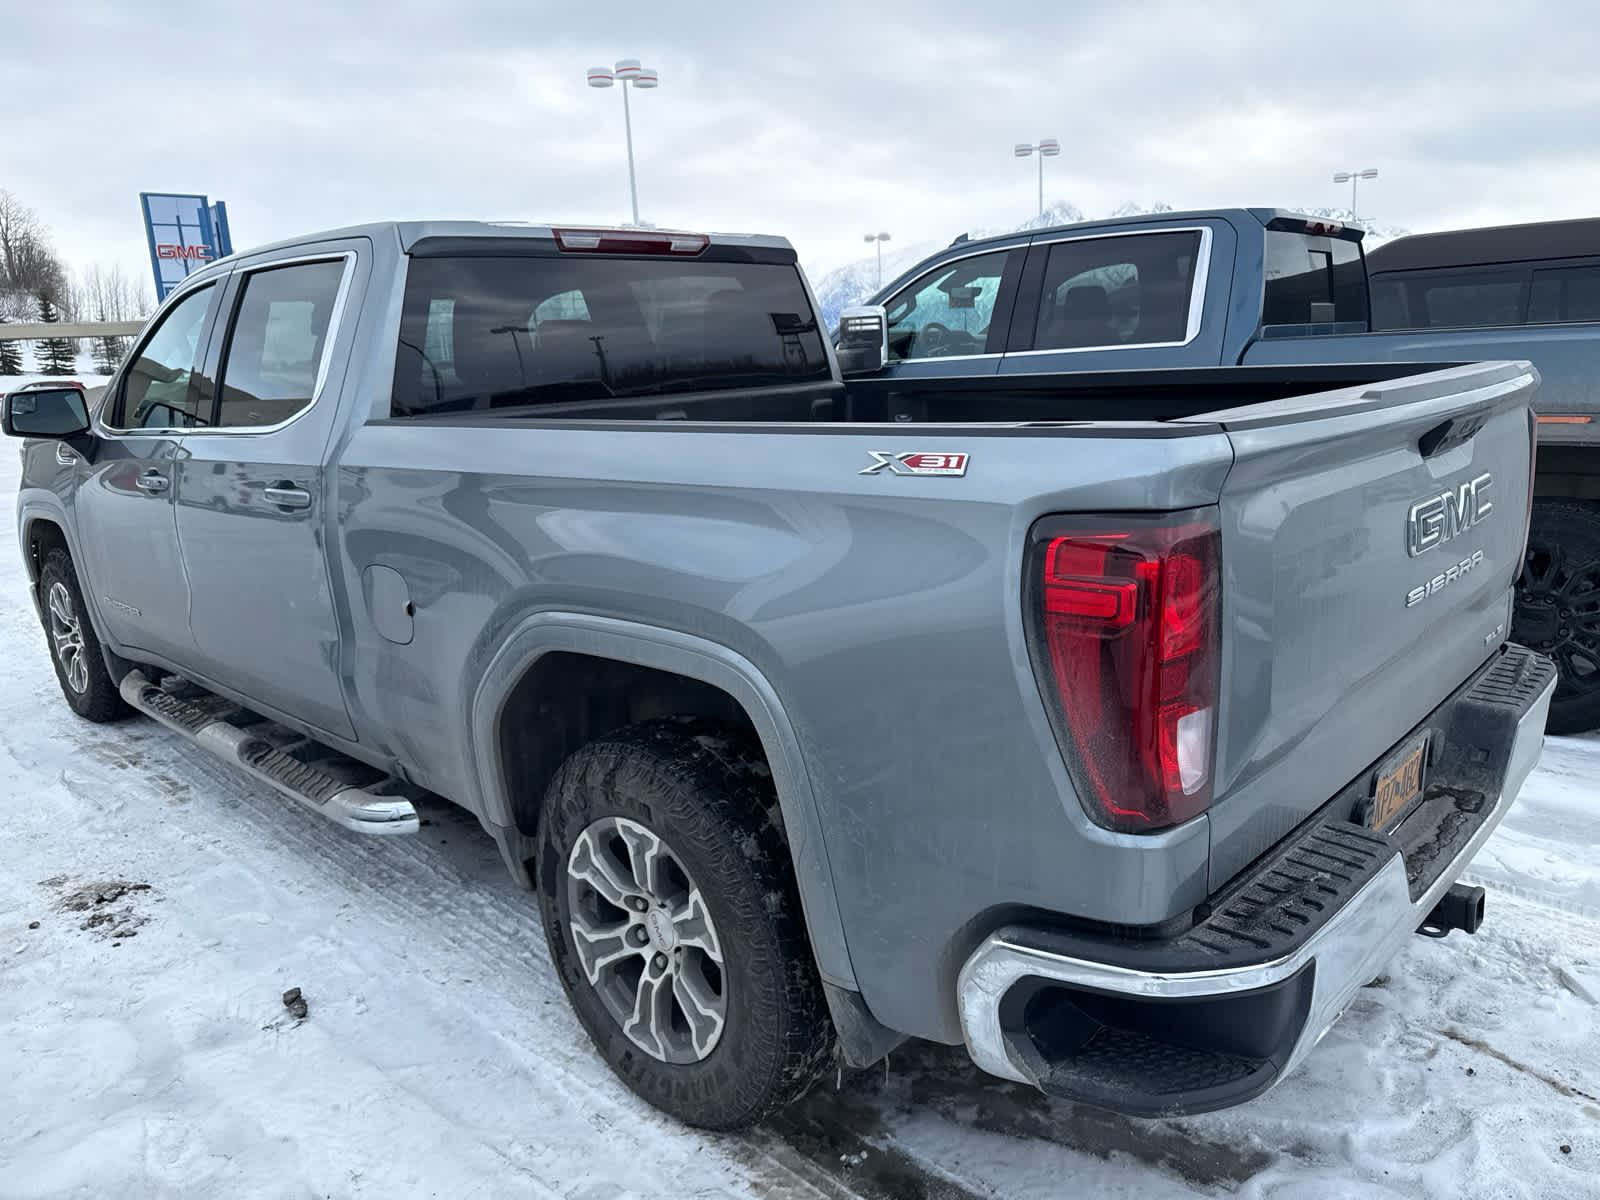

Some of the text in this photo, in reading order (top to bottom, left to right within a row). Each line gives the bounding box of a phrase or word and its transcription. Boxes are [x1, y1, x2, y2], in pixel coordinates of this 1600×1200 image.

[157, 244, 212, 260] GMC
[858, 450, 970, 477] X31
[1408, 473, 1493, 558] GMC
[1406, 549, 1484, 608] SIERRA
